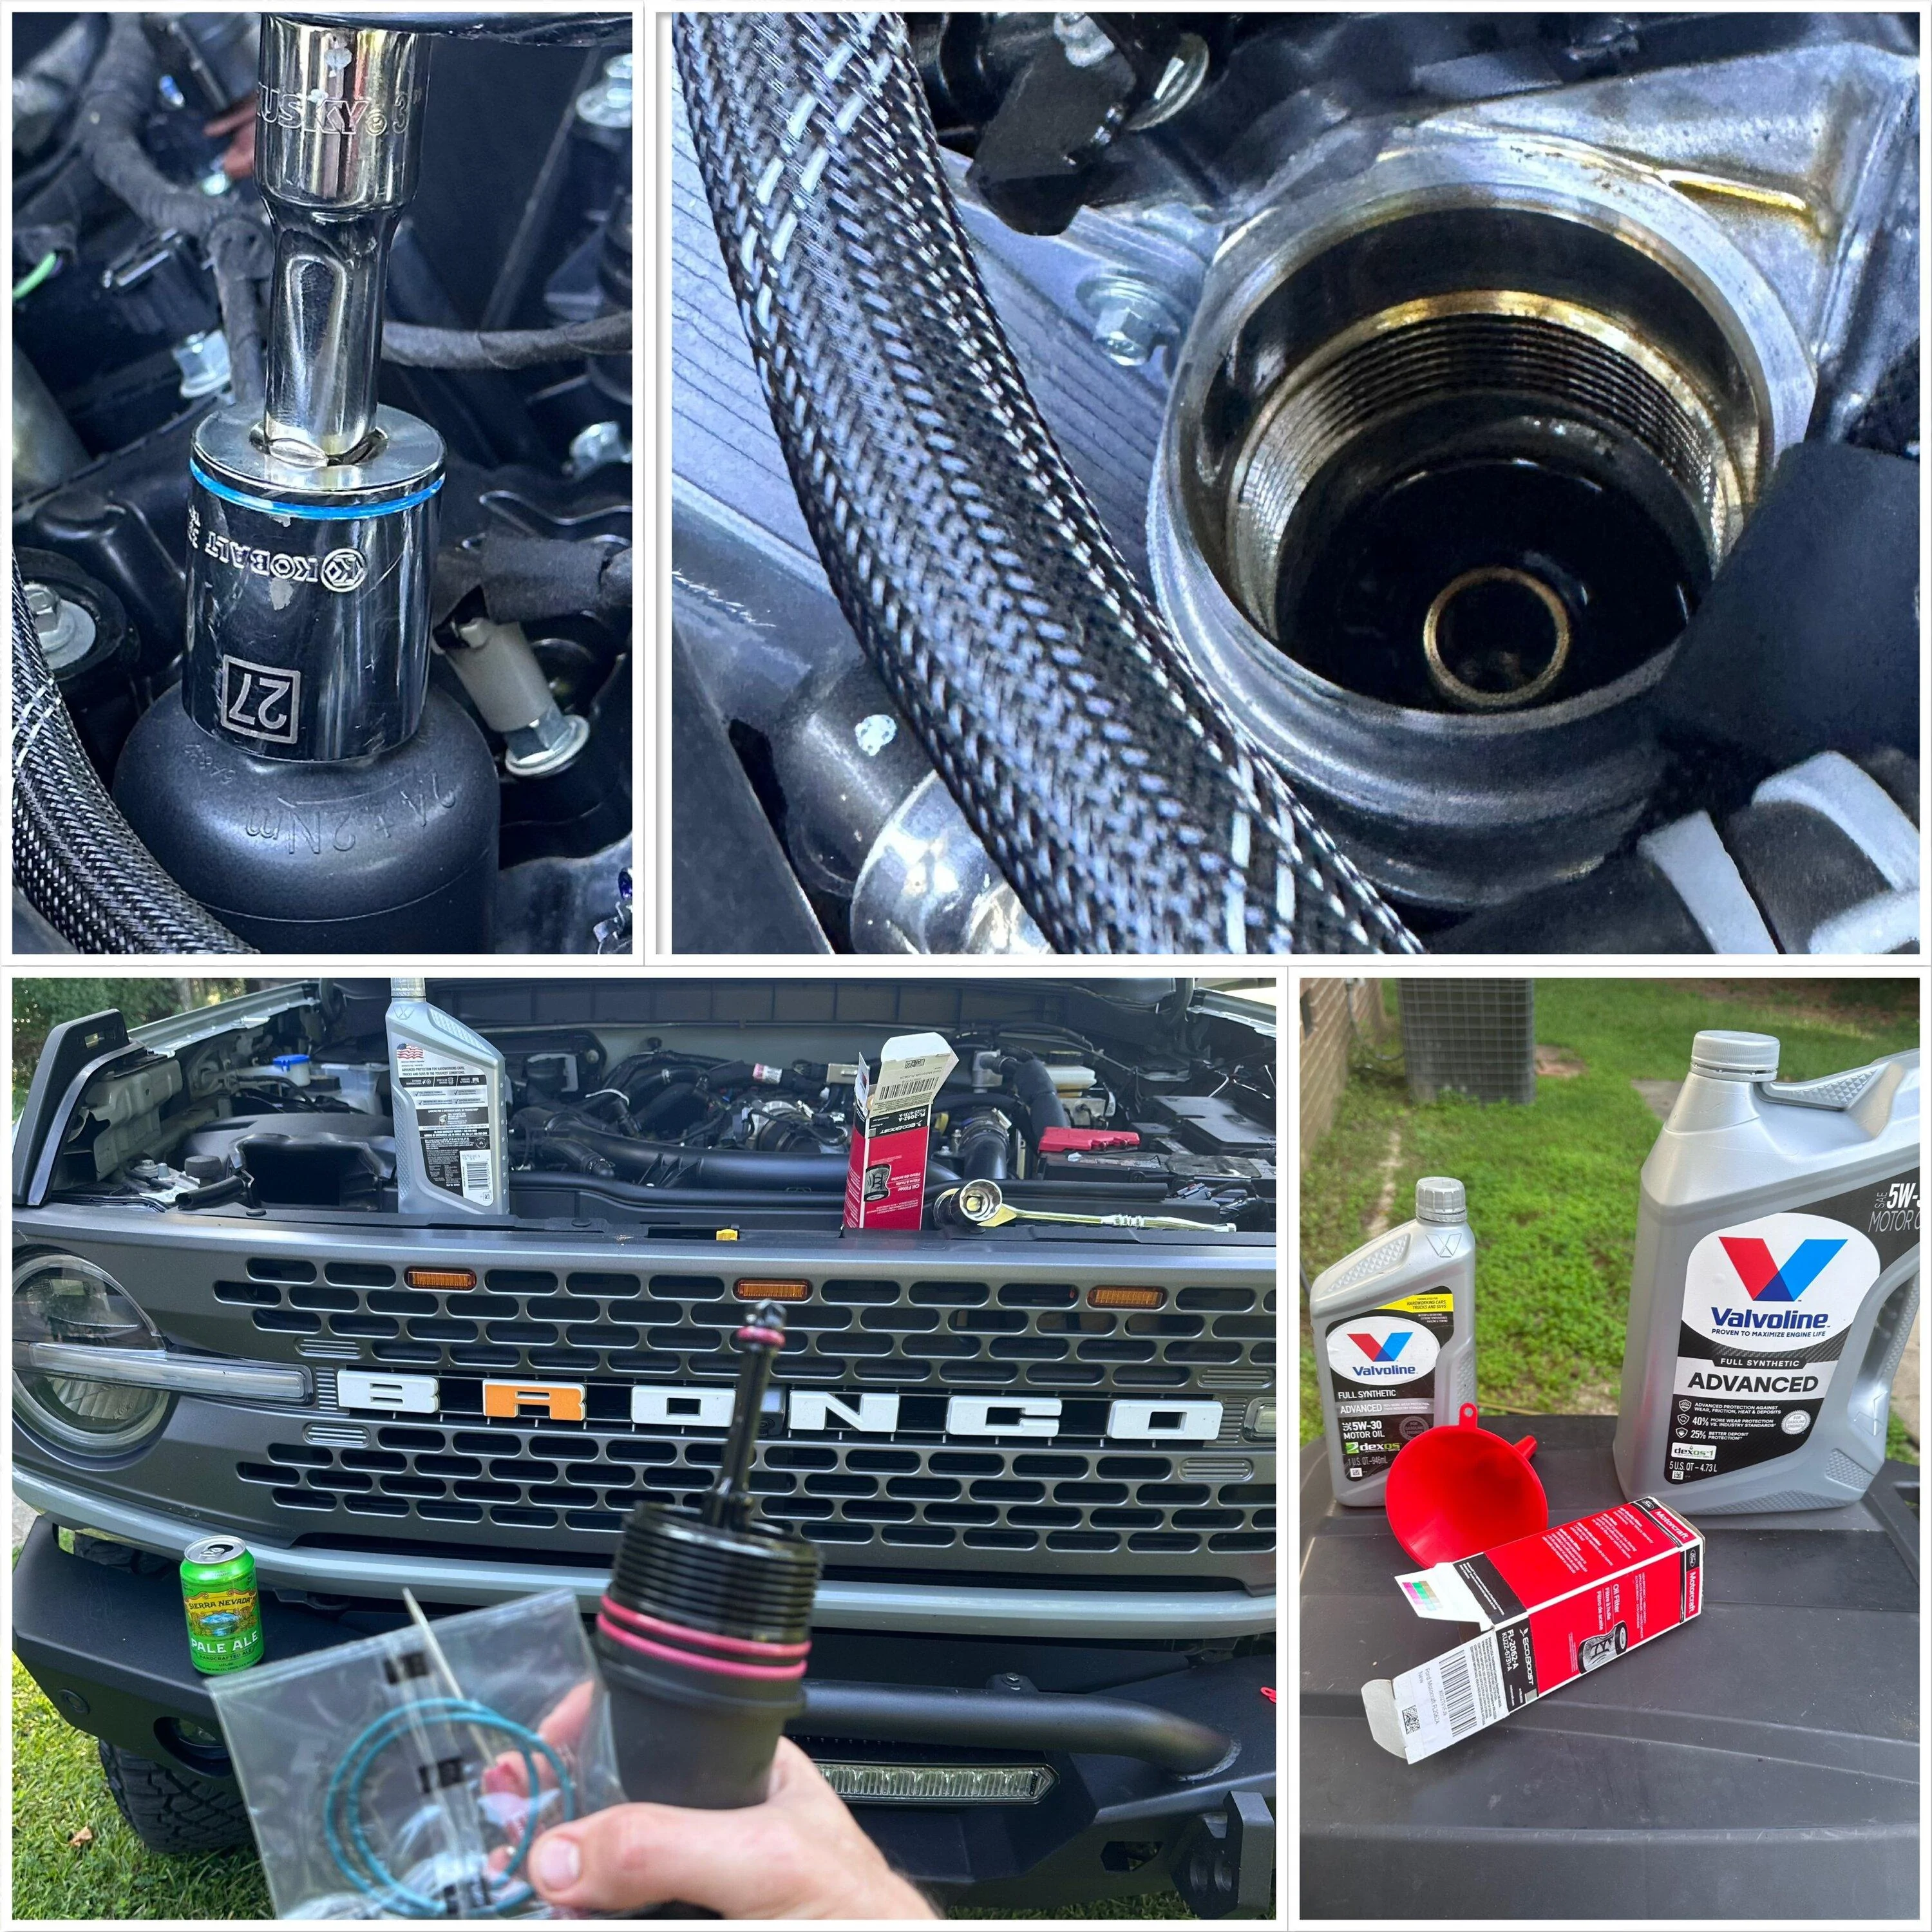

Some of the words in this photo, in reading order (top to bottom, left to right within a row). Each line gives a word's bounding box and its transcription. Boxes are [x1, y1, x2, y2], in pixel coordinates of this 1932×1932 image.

[256, 82, 371, 134] USKY
[204, 531, 319, 582] KOBALT
[229, 674, 291, 730] 27
[898, 1112, 925, 1122] FL-2062-A
[880, 1122, 916, 1134] ECOBOOST
[1874, 1192, 1888, 1208] SAE
[1868, 1209, 1914, 1233] MOTOR
[1711, 1307, 1828, 1329] Valvoline
[1352, 1365, 1416, 1376] Valvoline
[1687, 1372, 1819, 1393] ADVANCED
[1358, 1390, 1396, 1398] SYNTHETIC
[337, 1370, 1223, 1440] BRONCO
[1340, 1404, 1383, 1414] ADVANCED
[1352, 1421, 1382, 1431] 5W-30
[1692, 1417, 1709, 1426] 40%
[1343, 1430, 1370, 1440] MOTOR
[1690, 1430, 1706, 1439] 25%
[1674, 1462, 1685, 1470] U.S.
[1686, 1463, 1694, 1471] QT
[1700, 1464, 1713, 1472] 4.73
[1655, 1510, 1689, 1540] Motorcraft
[219, 1597, 250, 1607] NEVADA
[1689, 1571, 1697, 1614] Motorcraft
[1598, 1607, 1603, 1615] de
[191, 1638, 227, 1653] PALE
[232, 1631, 258, 1651] ALE
[1501, 1632, 1513, 1672] KU2Z-6731-A
[1507, 1629, 1519, 1670] FL-2062-A
[1522, 1636, 1534, 1685] ECOBOOST
[1432, 1705, 1441, 1725] FL2062A
